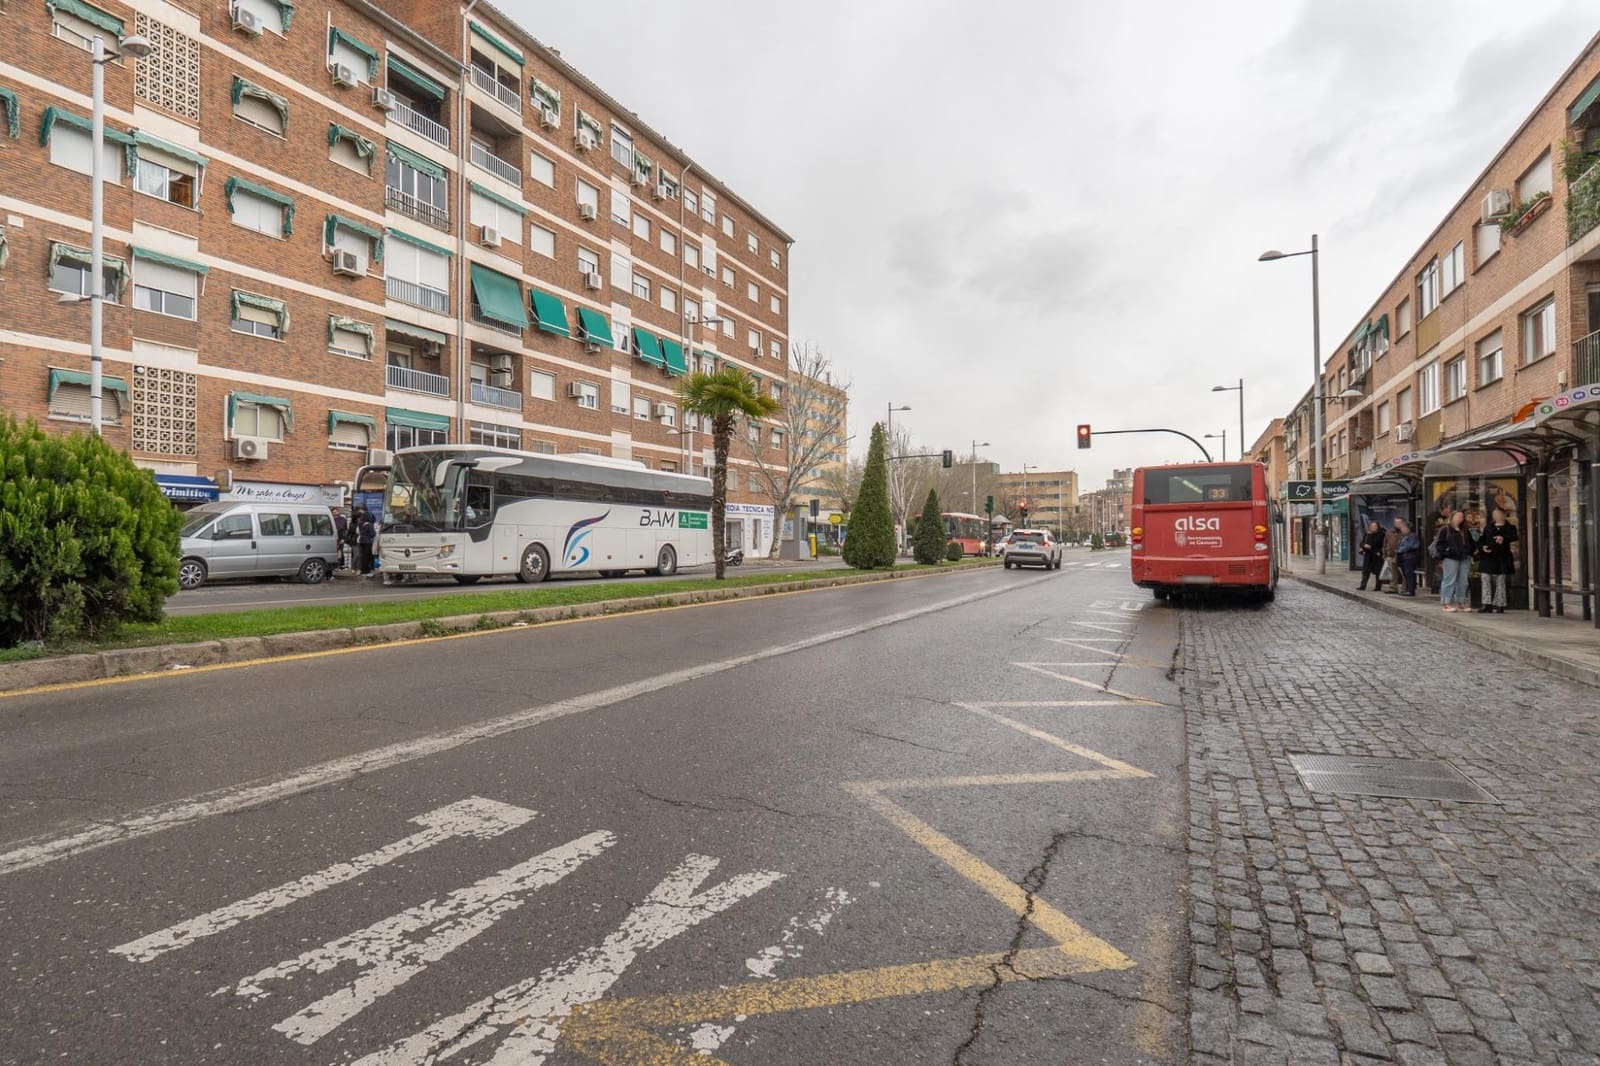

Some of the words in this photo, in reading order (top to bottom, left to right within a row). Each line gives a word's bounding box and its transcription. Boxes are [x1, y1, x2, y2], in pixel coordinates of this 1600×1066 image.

[1210, 488, 1225, 498] 33
[726, 504, 740, 512] EDIA
[639, 509, 675, 528] BAM
[1175, 515, 1220, 531] alsa
